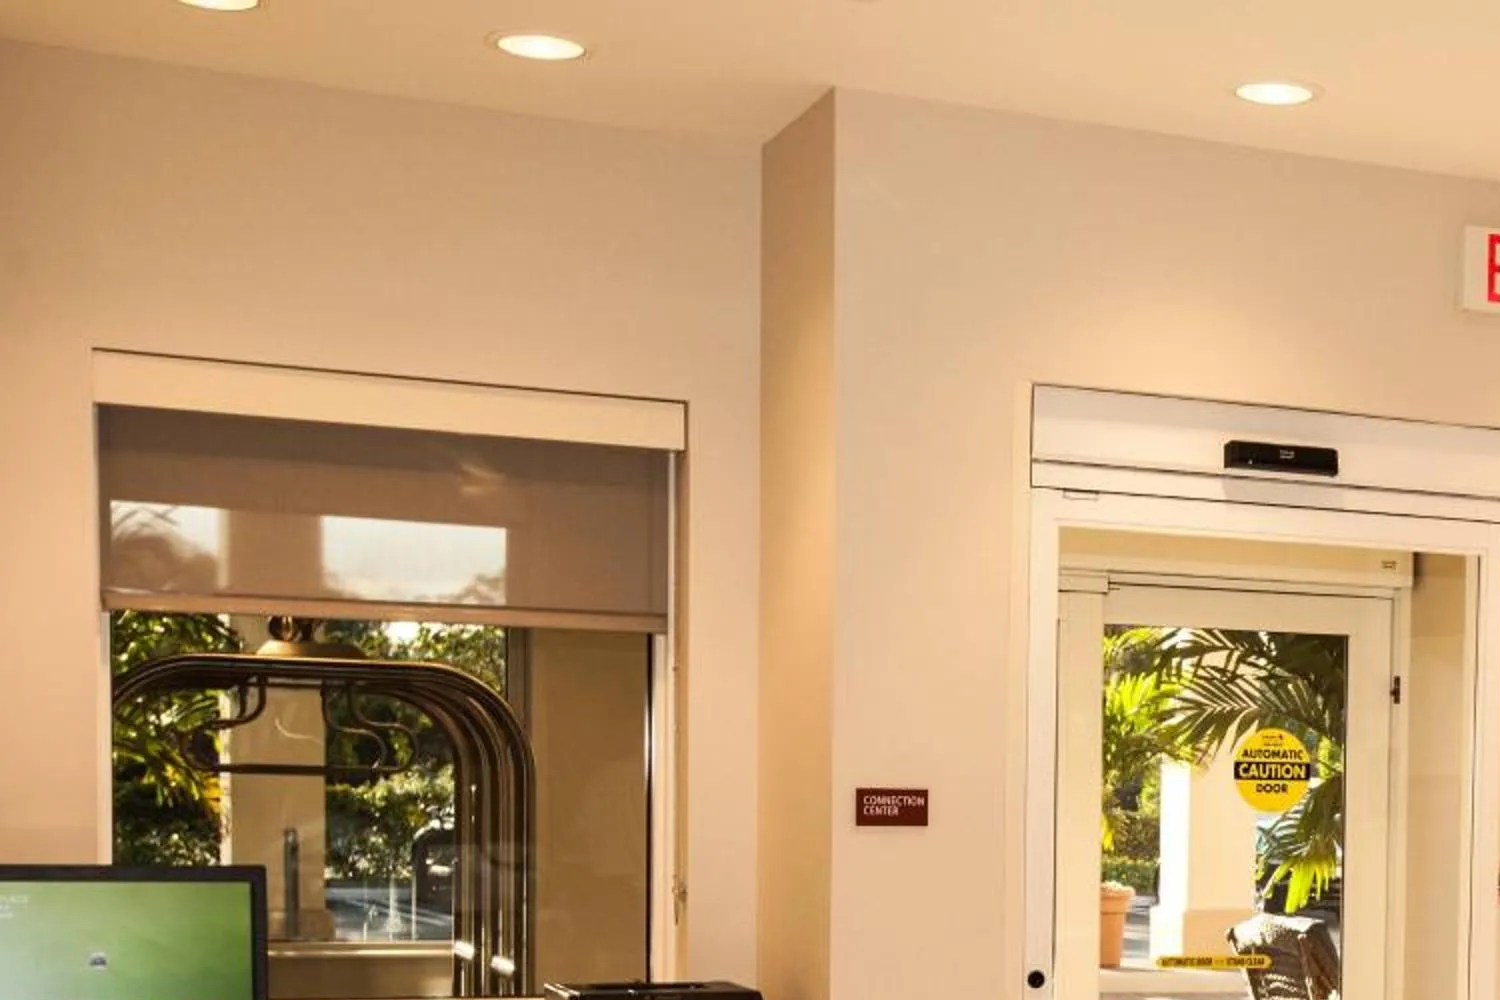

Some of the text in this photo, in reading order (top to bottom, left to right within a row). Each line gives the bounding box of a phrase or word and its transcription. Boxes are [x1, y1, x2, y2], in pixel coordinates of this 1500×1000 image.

[1242, 748, 1304, 761] AUTOMATIC
[1238, 762, 1307, 779] CAUTION
[1255, 783, 1289, 794] DOOR
[863, 795, 925, 806] CONNECTION
[863, 805, 899, 817] CENTER
